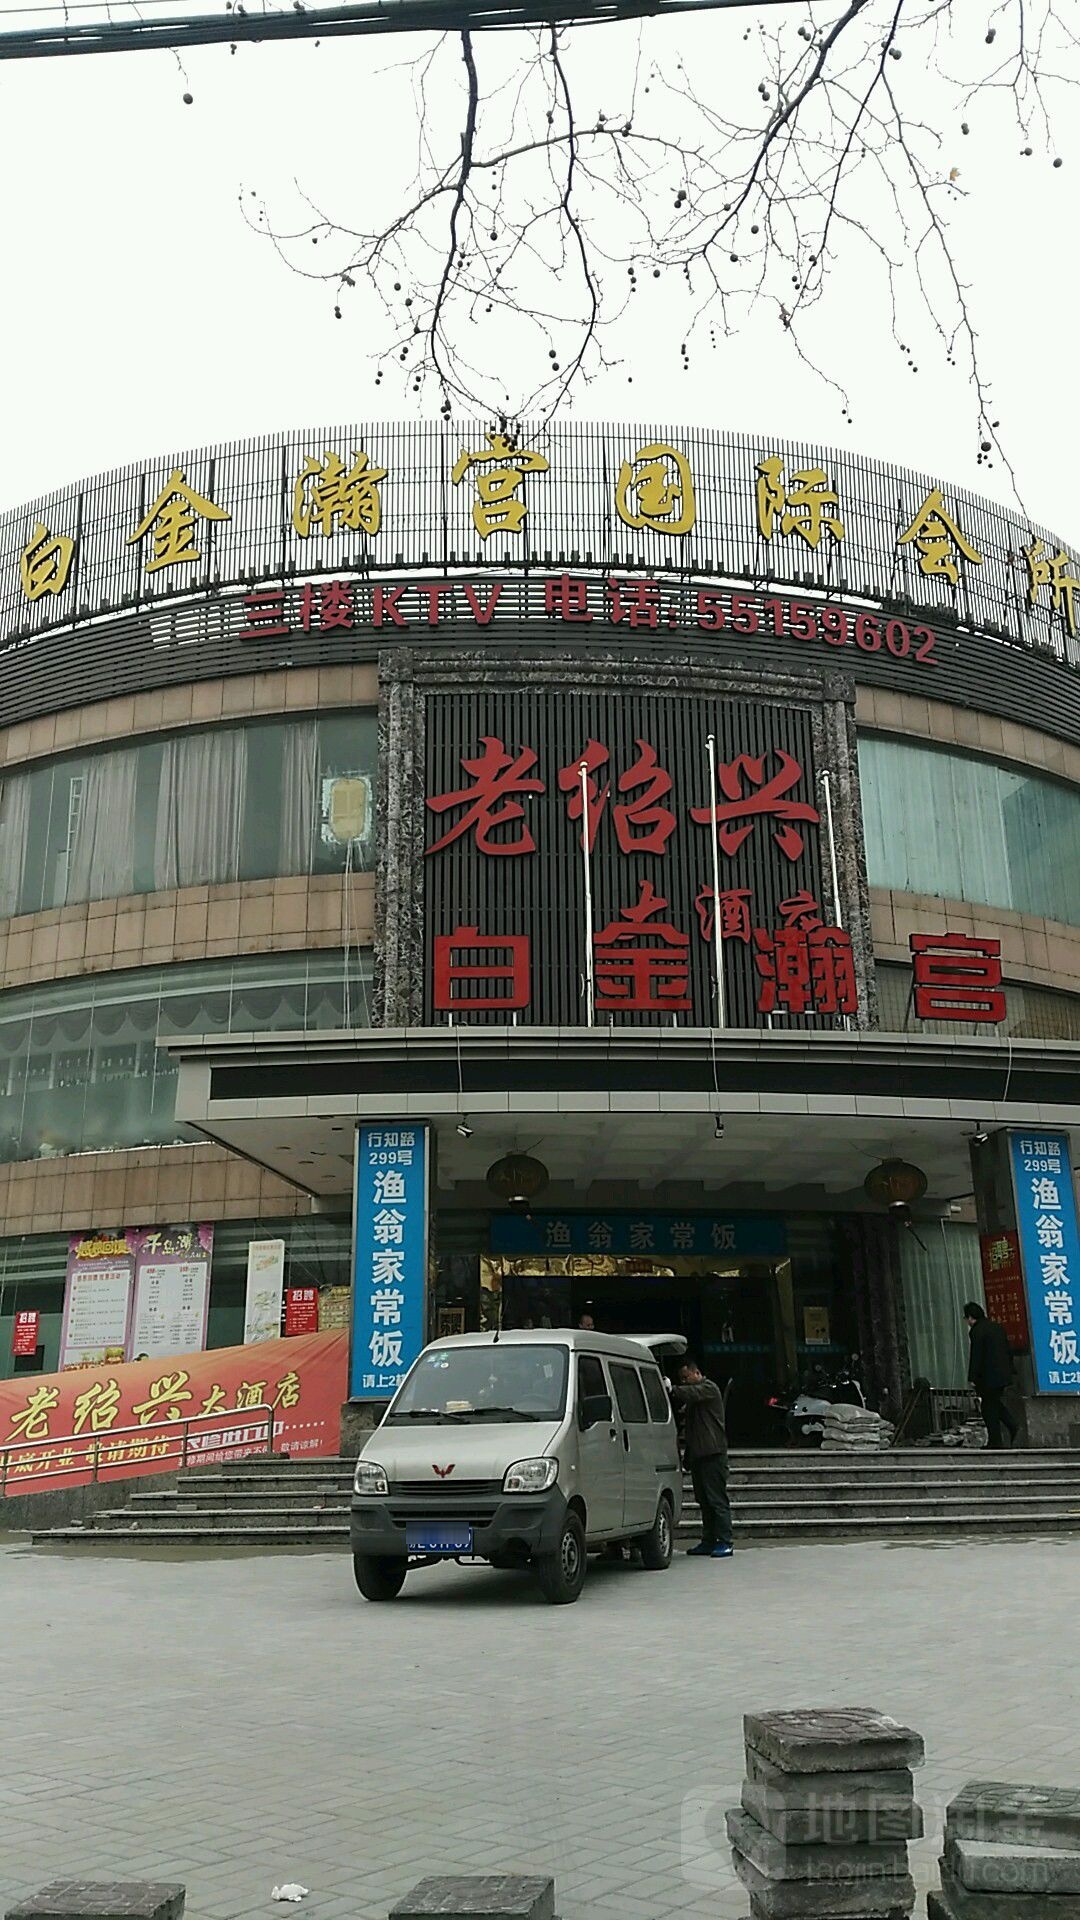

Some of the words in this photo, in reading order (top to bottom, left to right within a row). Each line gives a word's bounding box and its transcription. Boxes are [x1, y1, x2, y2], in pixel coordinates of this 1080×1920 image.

[239, 580, 504, 641] 三楼KTV
[424, 736, 820, 862] 老绍兴
[433, 925, 1006, 1023] 白金瀚宫
[367, 1132, 416, 1148] 行知路
[369, 1150, 413, 1166] 299号
[1020, 1140, 1060, 1156] 行知路
[1024, 1159, 1061, 1174] 299号
[546, 1221, 738, 1251] 渔翁家常饭
[369, 1170, 407, 1368] 渔翁家常饭
[1030, 1177, 1080, 1365] 渔翁家常饭
